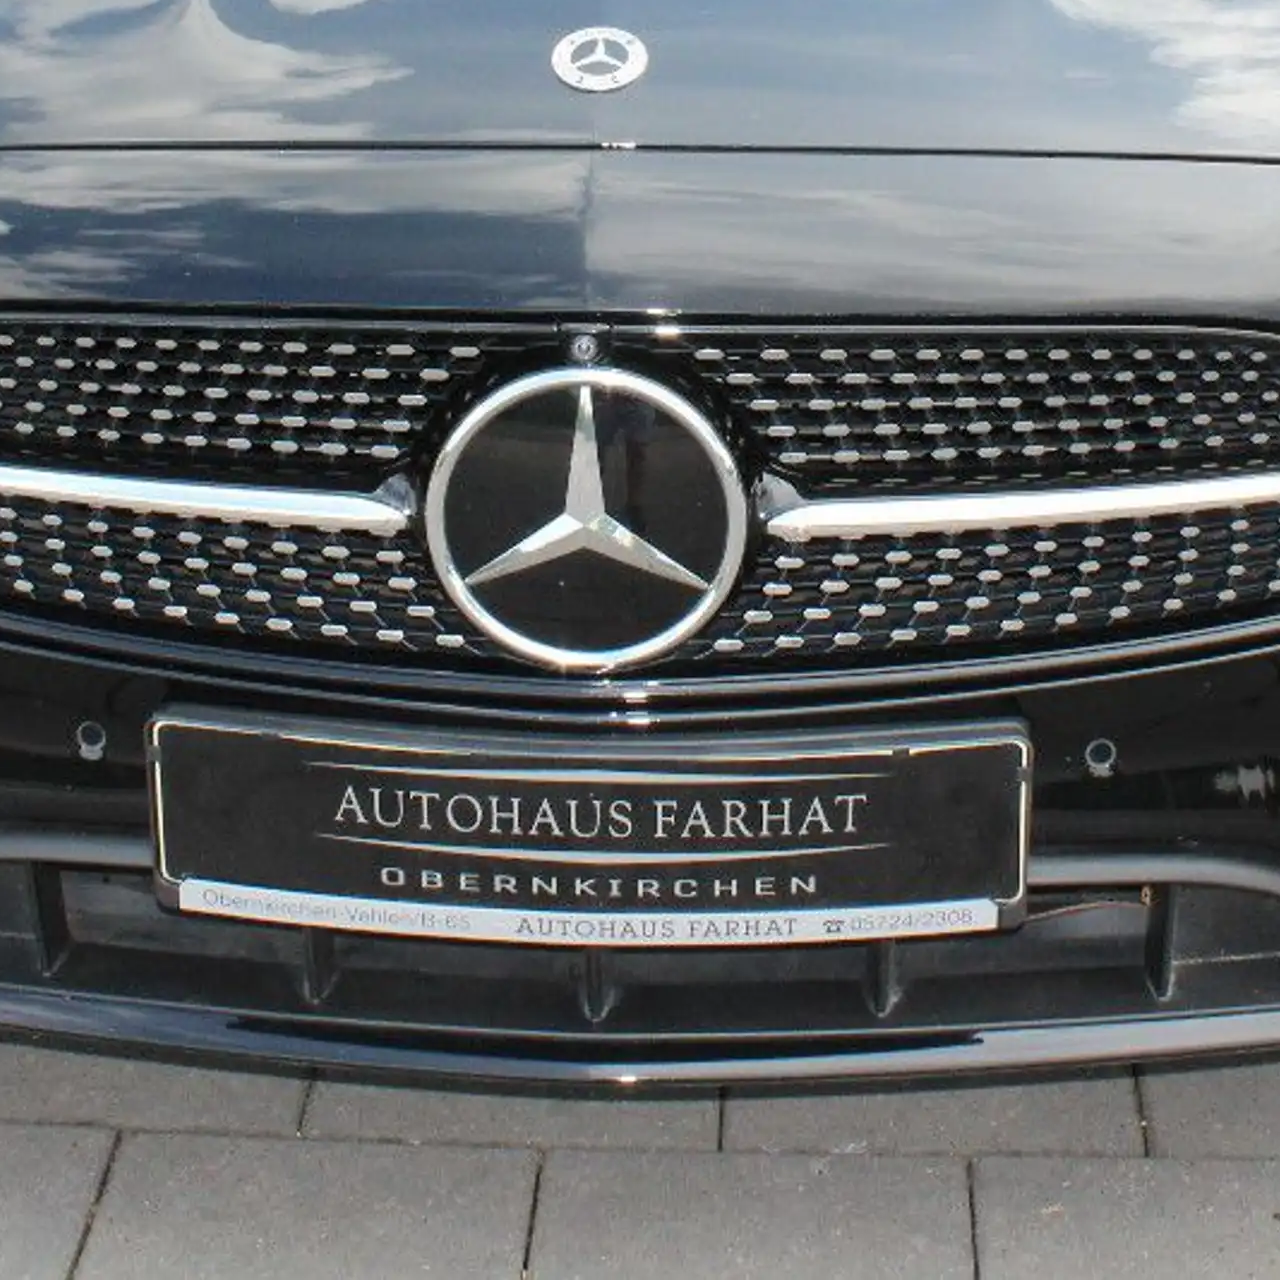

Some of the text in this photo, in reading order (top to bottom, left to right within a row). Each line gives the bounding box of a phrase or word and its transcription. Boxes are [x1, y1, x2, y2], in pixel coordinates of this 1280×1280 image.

[333, 784, 868, 839] AUTOHAUS FARHAT
[380, 866, 818, 898] OBERNKIRCHEN
[515, 917, 676, 939] AUTOHAUS
[688, 917, 798, 938] FARHAT
